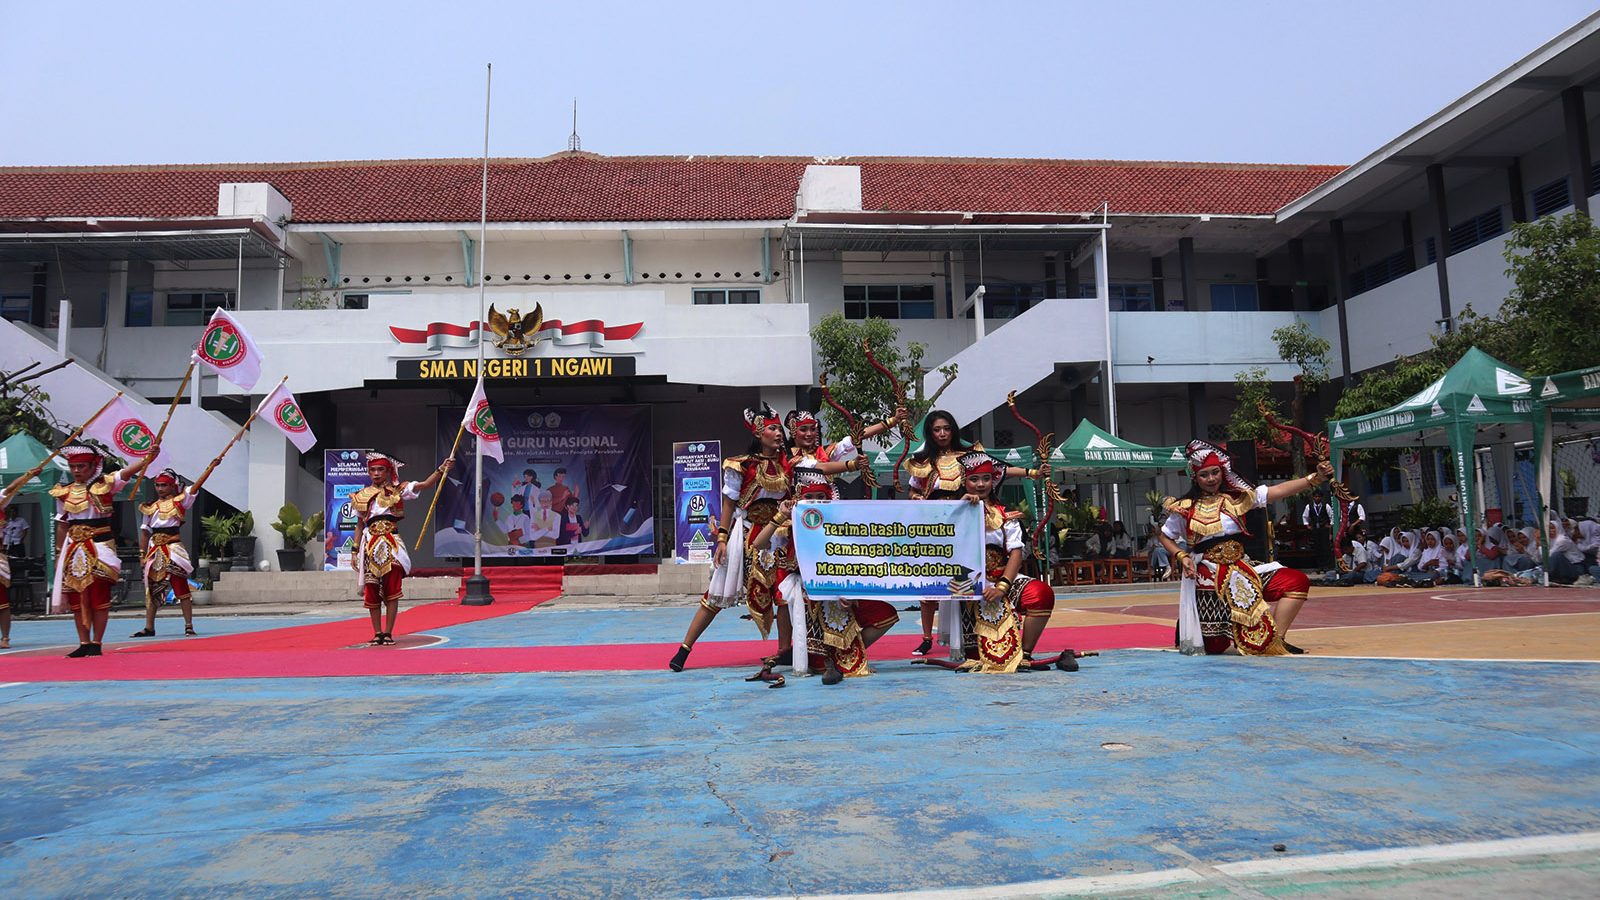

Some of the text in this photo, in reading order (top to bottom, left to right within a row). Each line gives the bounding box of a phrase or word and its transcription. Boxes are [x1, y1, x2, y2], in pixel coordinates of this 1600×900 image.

[420, 360, 458, 378] SMA
[534, 359, 541, 376] 1
[551, 358, 612, 376] NGAWI
[507, 437, 545, 448] GURU
[549, 435, 618, 448] NASIONAL
[1084, 451, 1153, 460] BANK SYARIAH NGAWI
[1457, 451, 1465, 478] PUSAT
[692, 496, 704, 510] BA
[823, 522, 955, 538] Terima kasih guruku
[825, 542, 953, 558] Semangat berjuang
[816, 562, 962, 577] Memerangi kebodohan
